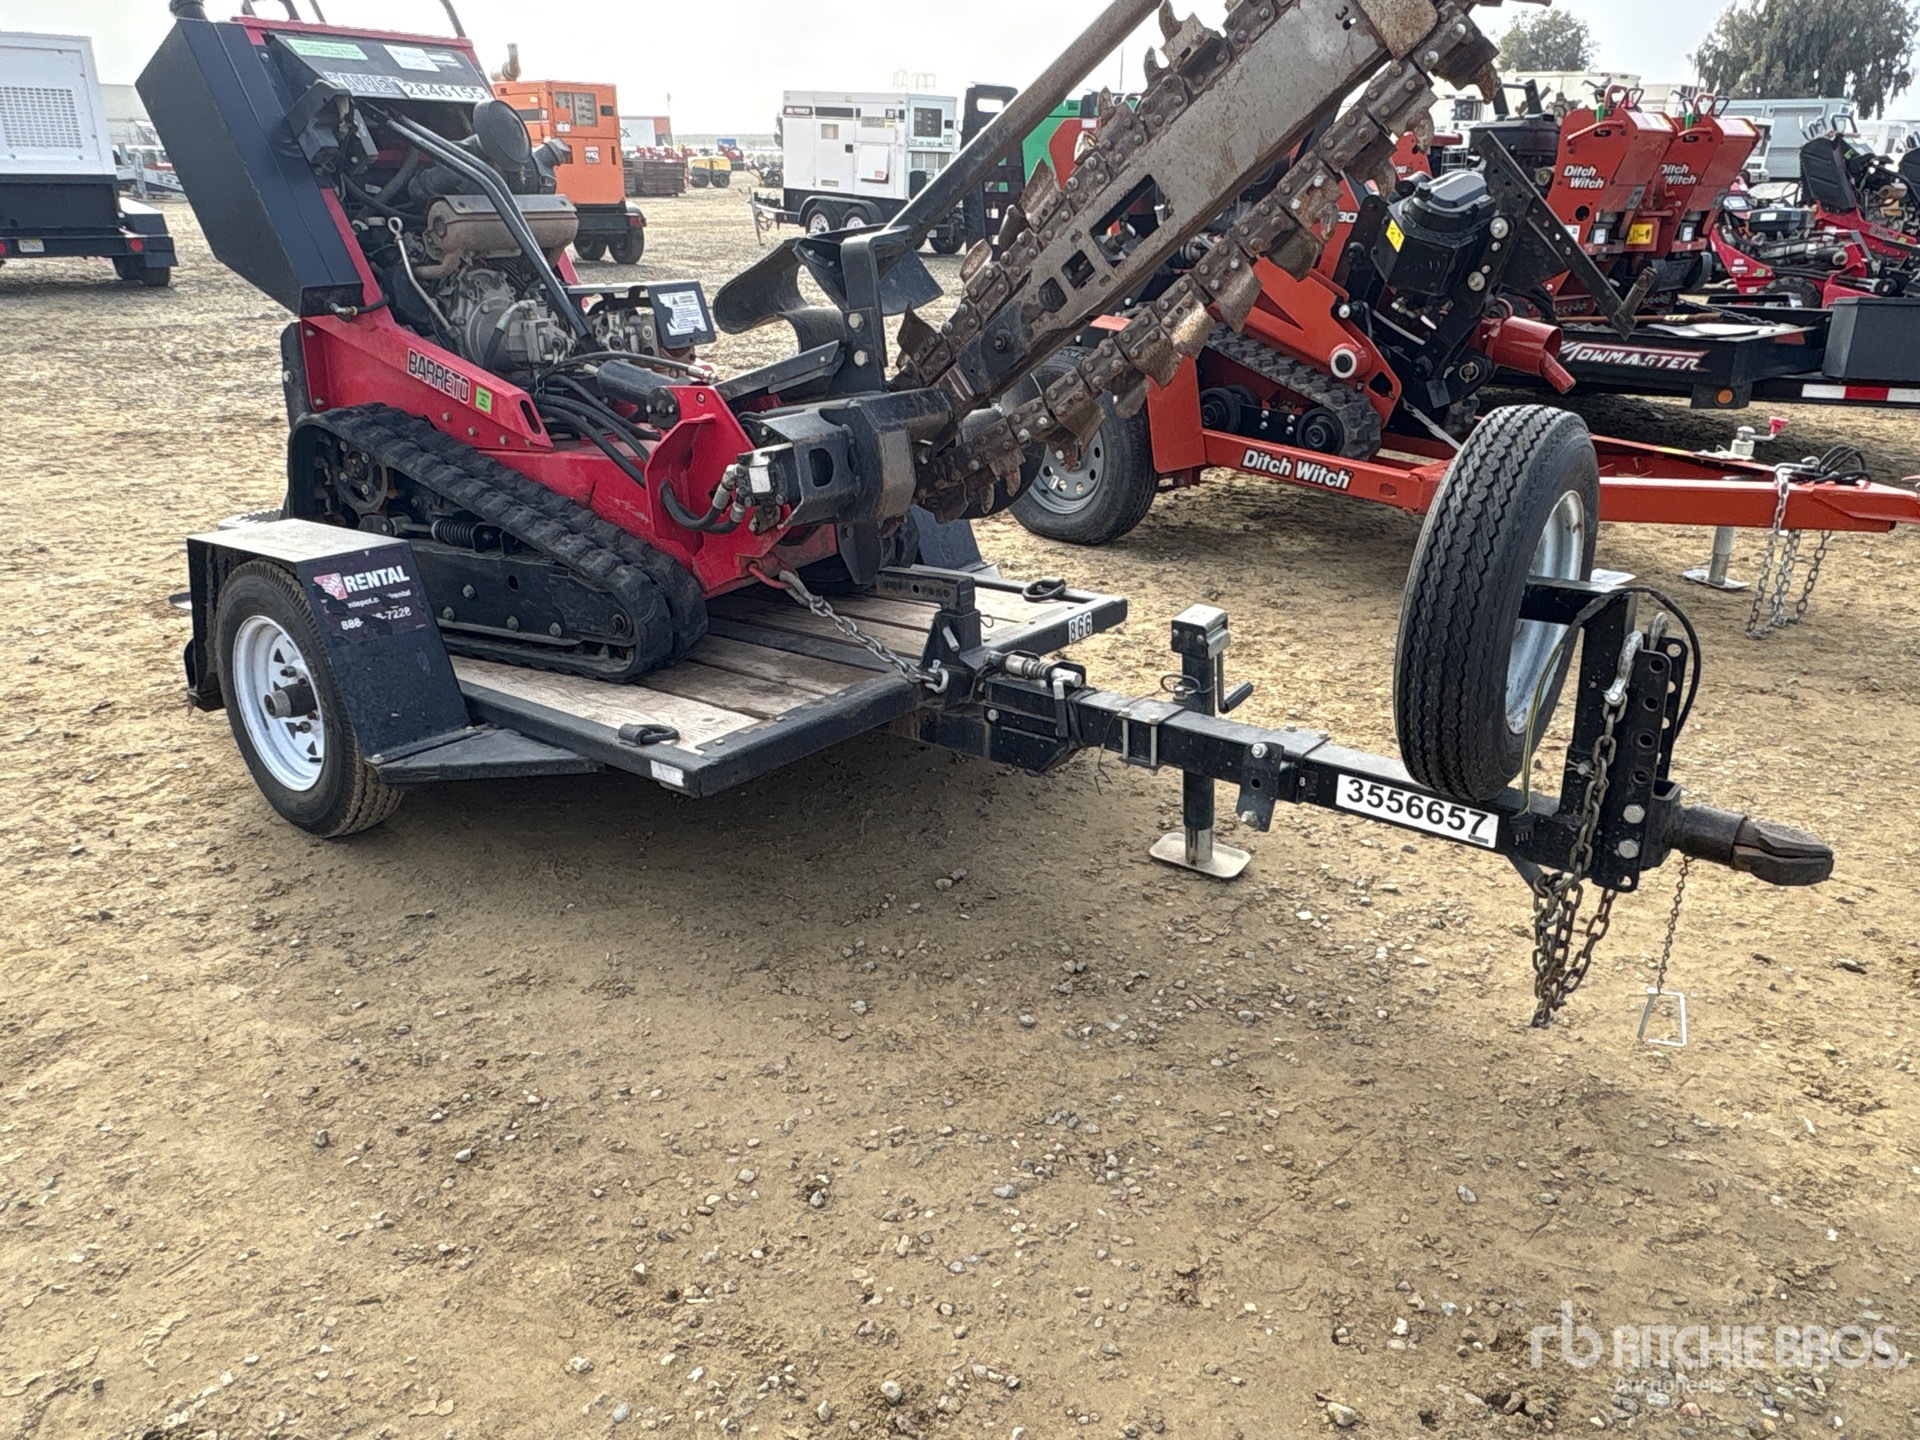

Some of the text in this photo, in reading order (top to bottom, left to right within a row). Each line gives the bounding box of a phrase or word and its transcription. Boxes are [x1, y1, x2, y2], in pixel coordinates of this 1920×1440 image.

[403, 82, 485, 100] 2846155
[1563, 164, 1597, 178] Ditch
[1570, 177, 1605, 190] Witch
[408, 348, 470, 404] BARRETO
[1242, 449, 1351, 490] Ditch Witch
[343, 565, 411, 593] RENTAL
[1070, 614, 1092, 642] 866
[1346, 779, 1489, 836] 3556657
